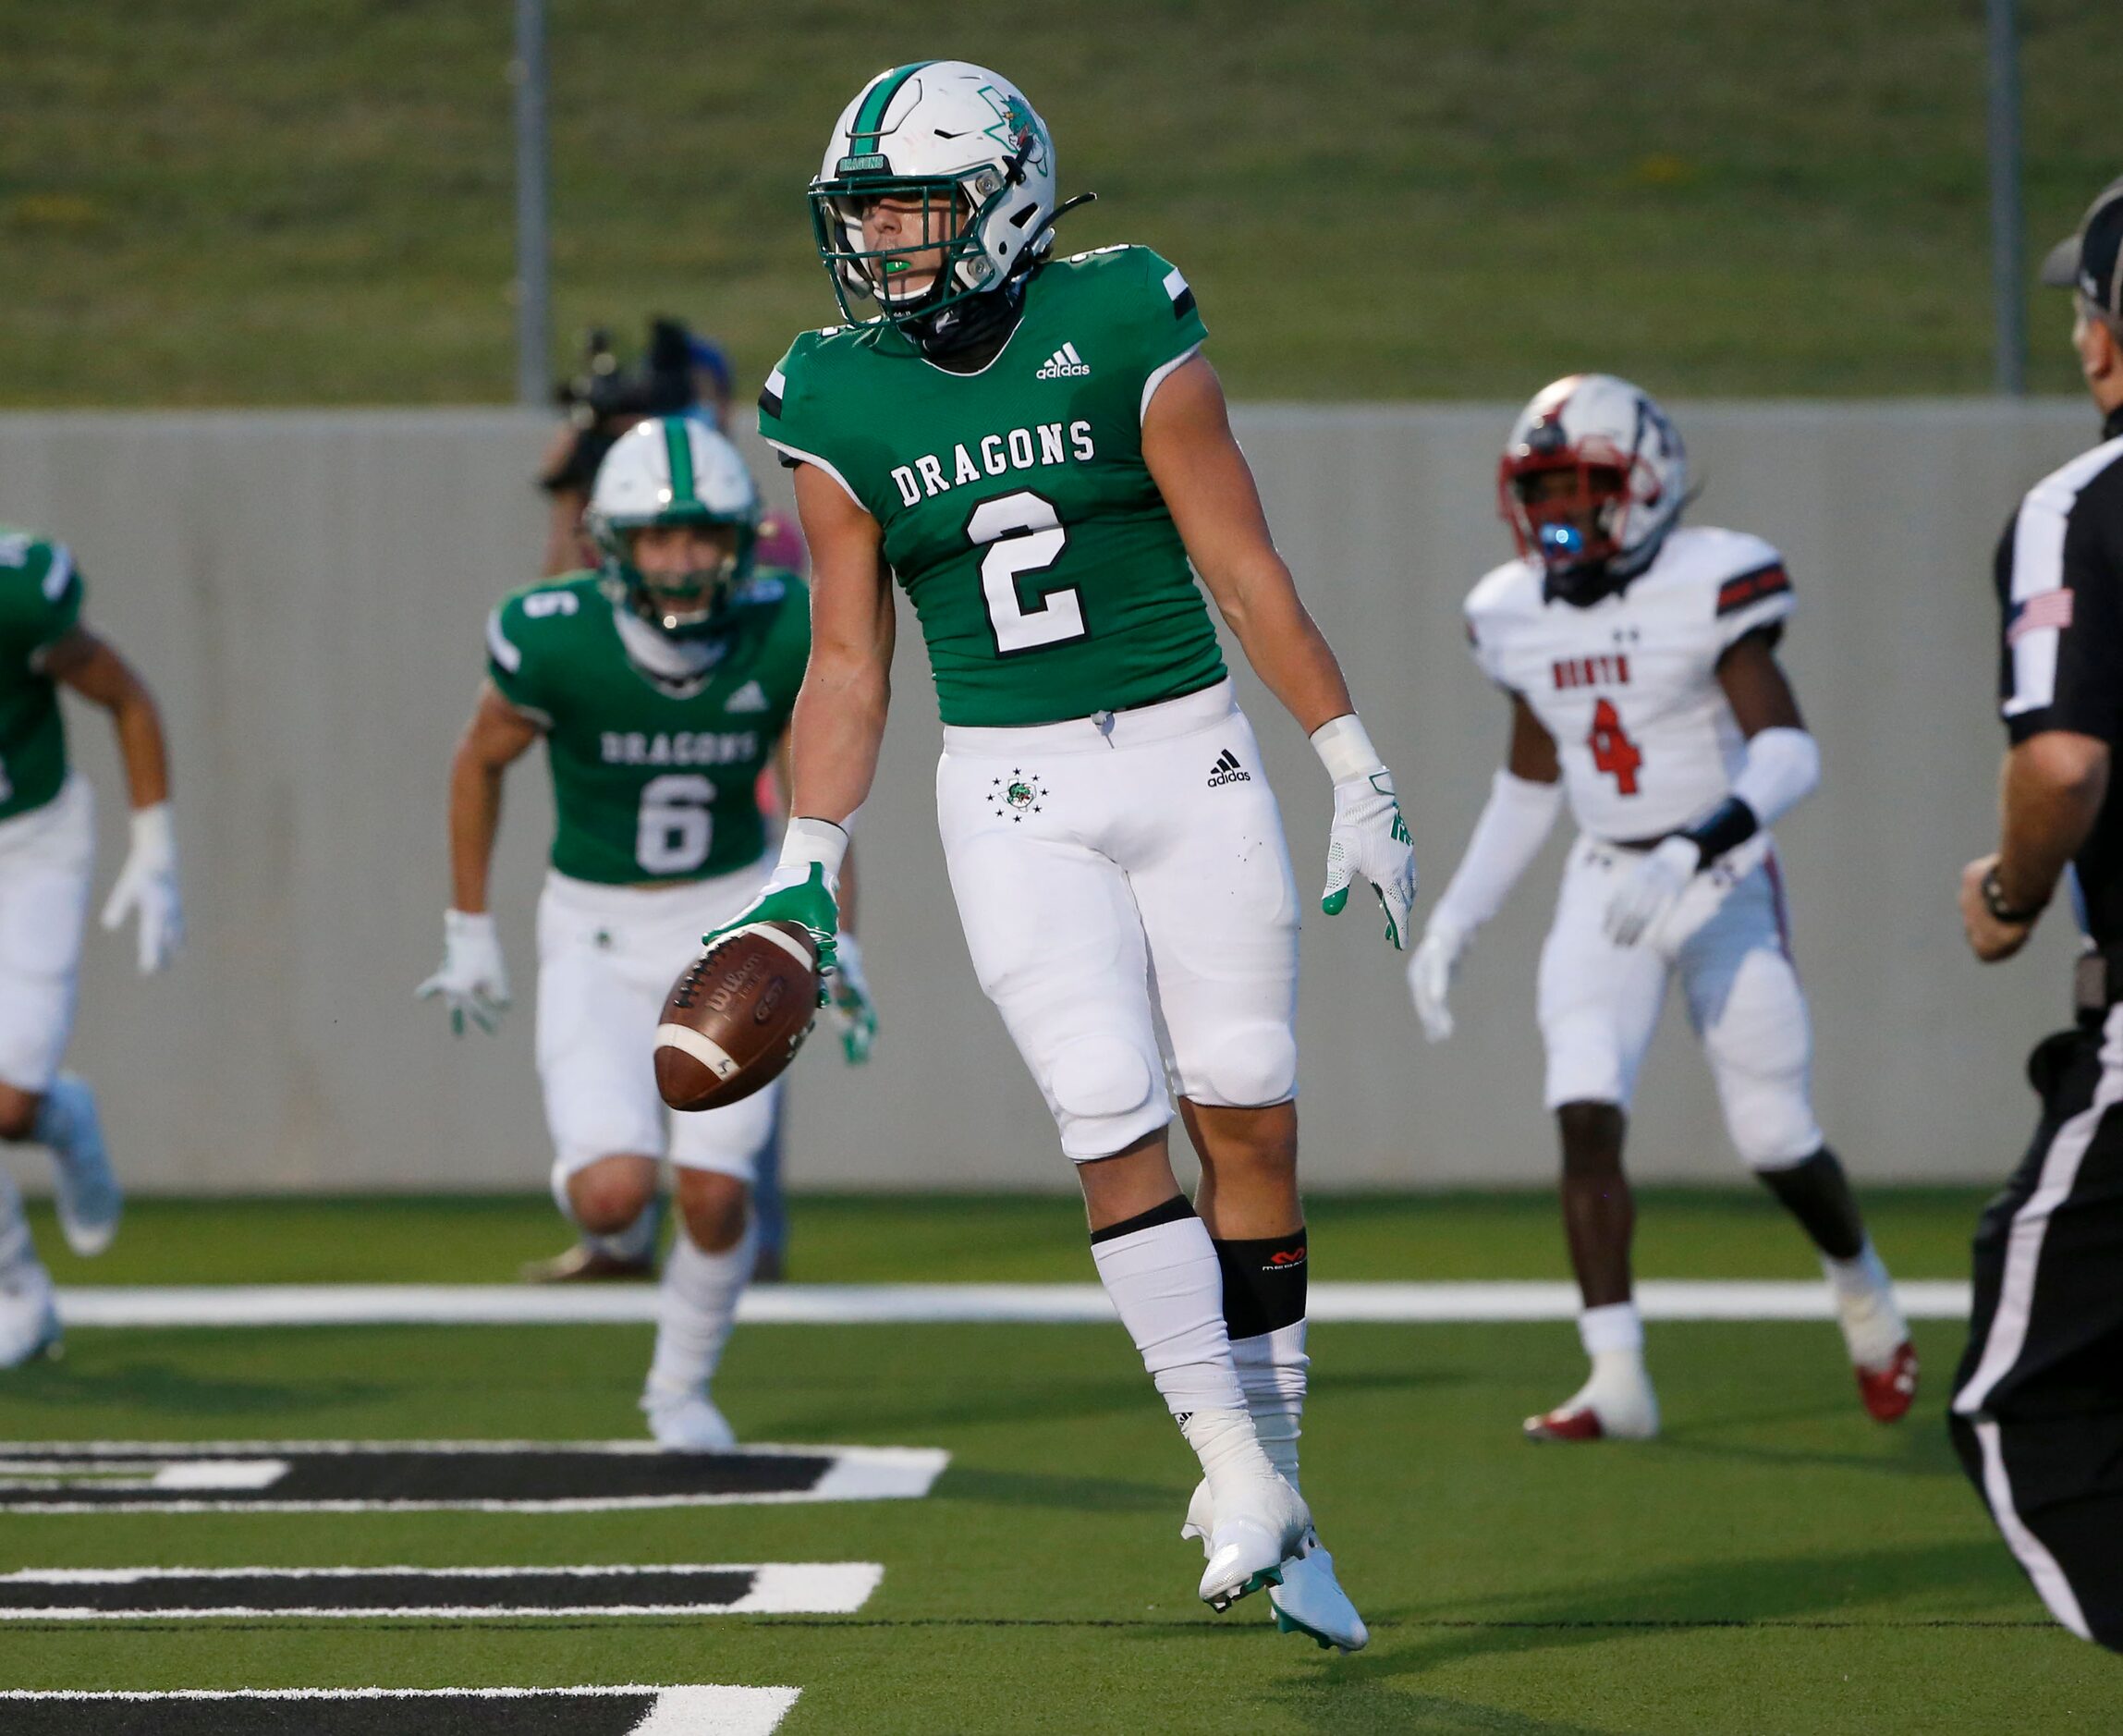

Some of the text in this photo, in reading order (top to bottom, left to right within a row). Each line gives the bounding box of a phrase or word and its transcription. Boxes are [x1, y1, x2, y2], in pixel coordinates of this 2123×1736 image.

[1036, 363, 1091, 380] adidas
[888, 419, 1096, 508] DRAGONS
[964, 487, 1091, 658] 2
[601, 730, 757, 765] DRAGONS
[1207, 769, 1251, 788] adidas
[1587, 696, 1642, 796] 4
[636, 774, 717, 874] 6
[708, 953, 763, 1012] Wilson
